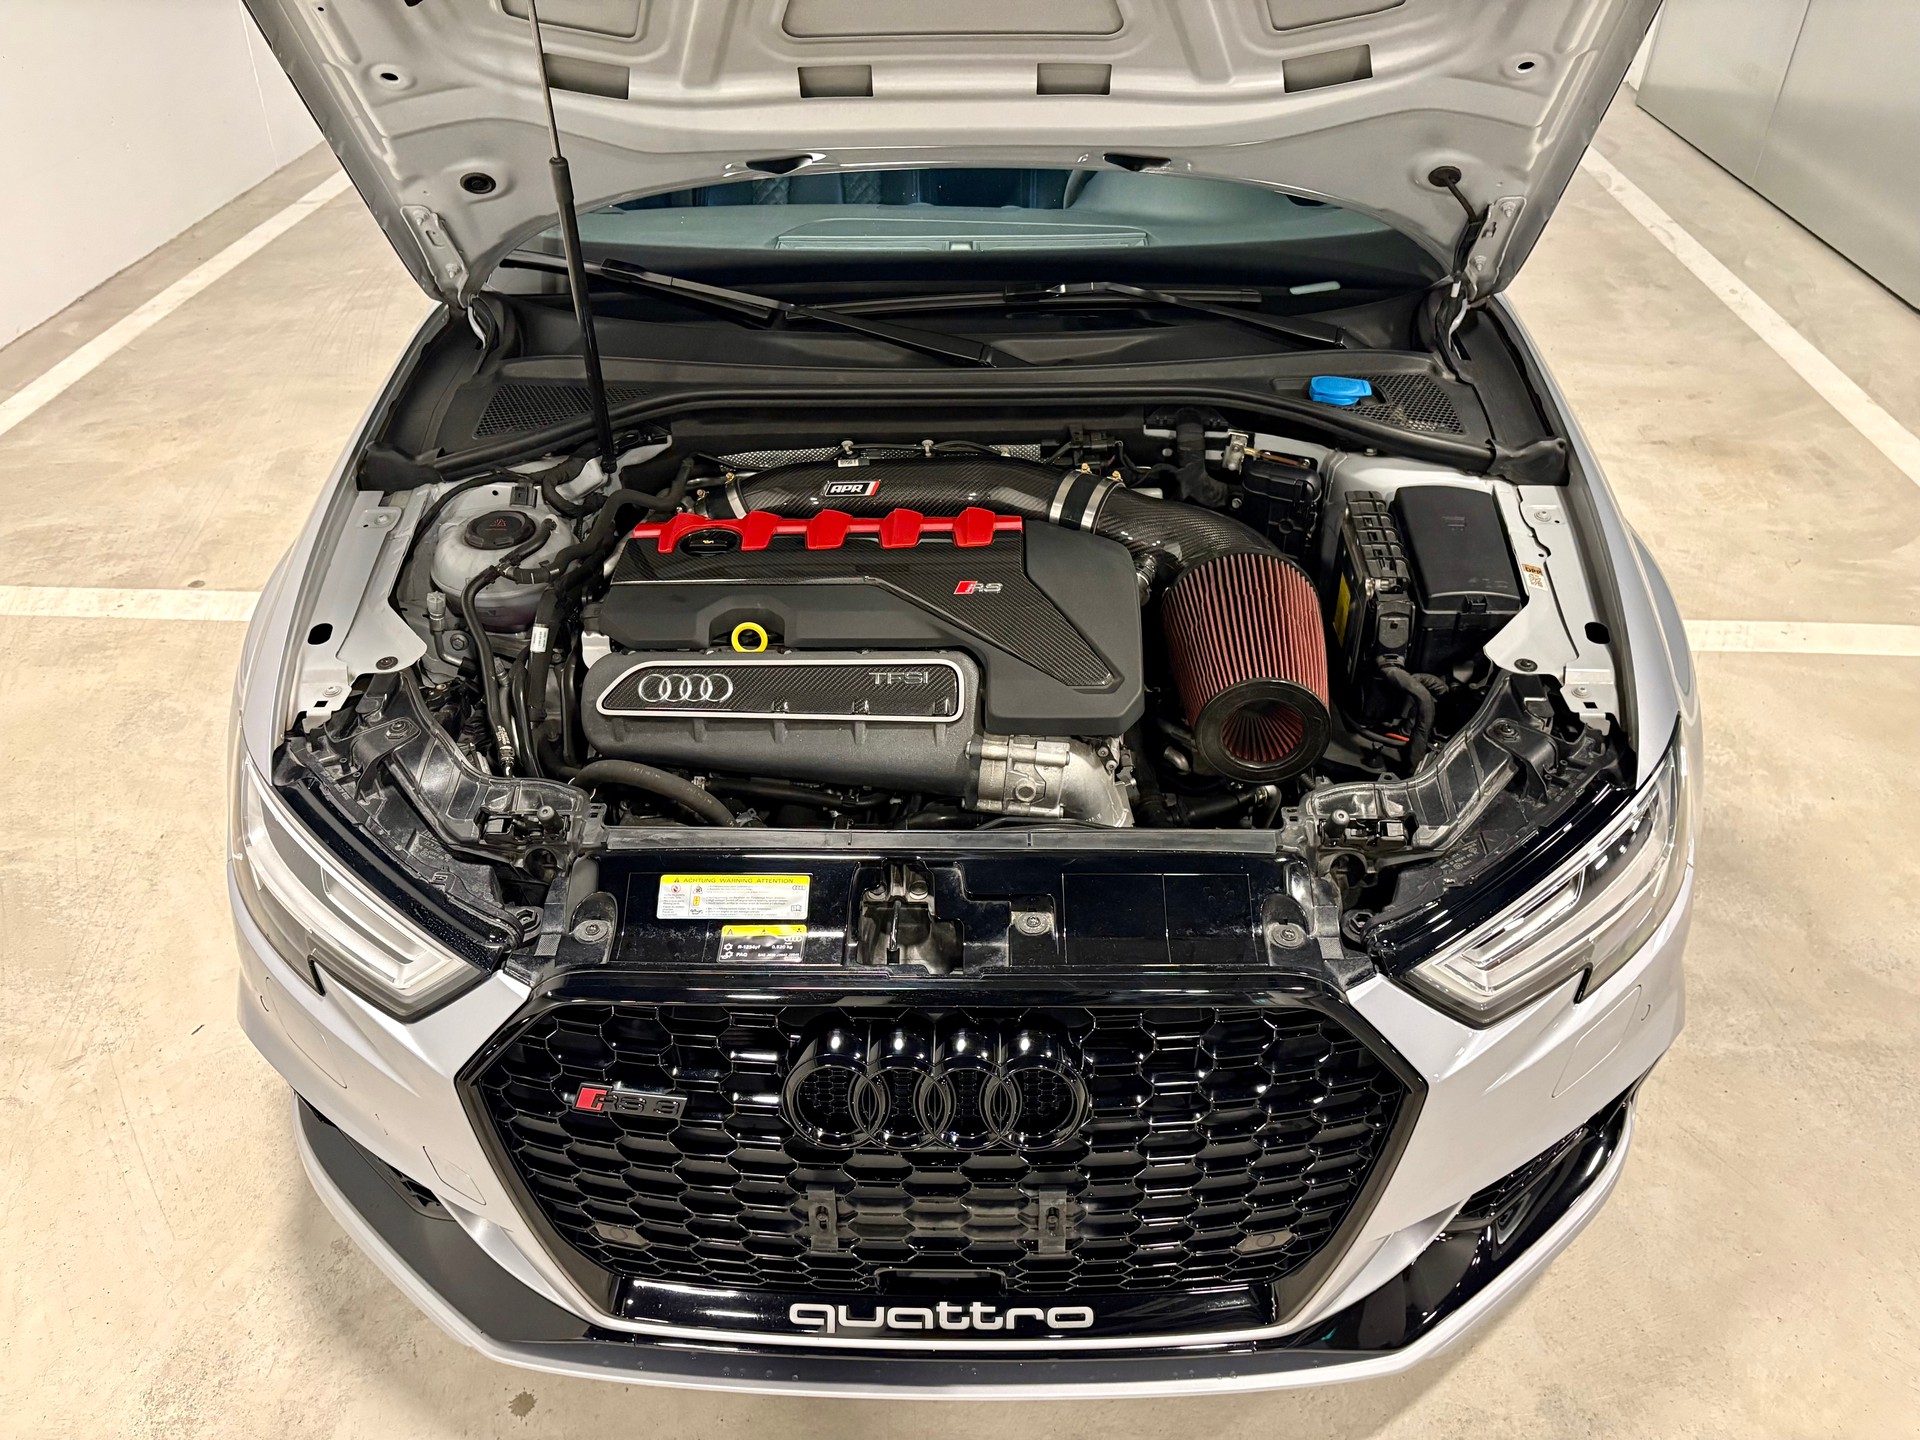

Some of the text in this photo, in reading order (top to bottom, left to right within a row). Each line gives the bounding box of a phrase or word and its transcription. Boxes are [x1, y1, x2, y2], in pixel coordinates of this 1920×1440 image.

[829, 484, 864, 493] APR
[964, 582, 1004, 594] RS
[868, 671, 929, 685] TFSI
[590, 1093, 680, 1116] RS 3
[788, 1301, 1094, 1334] quattro
